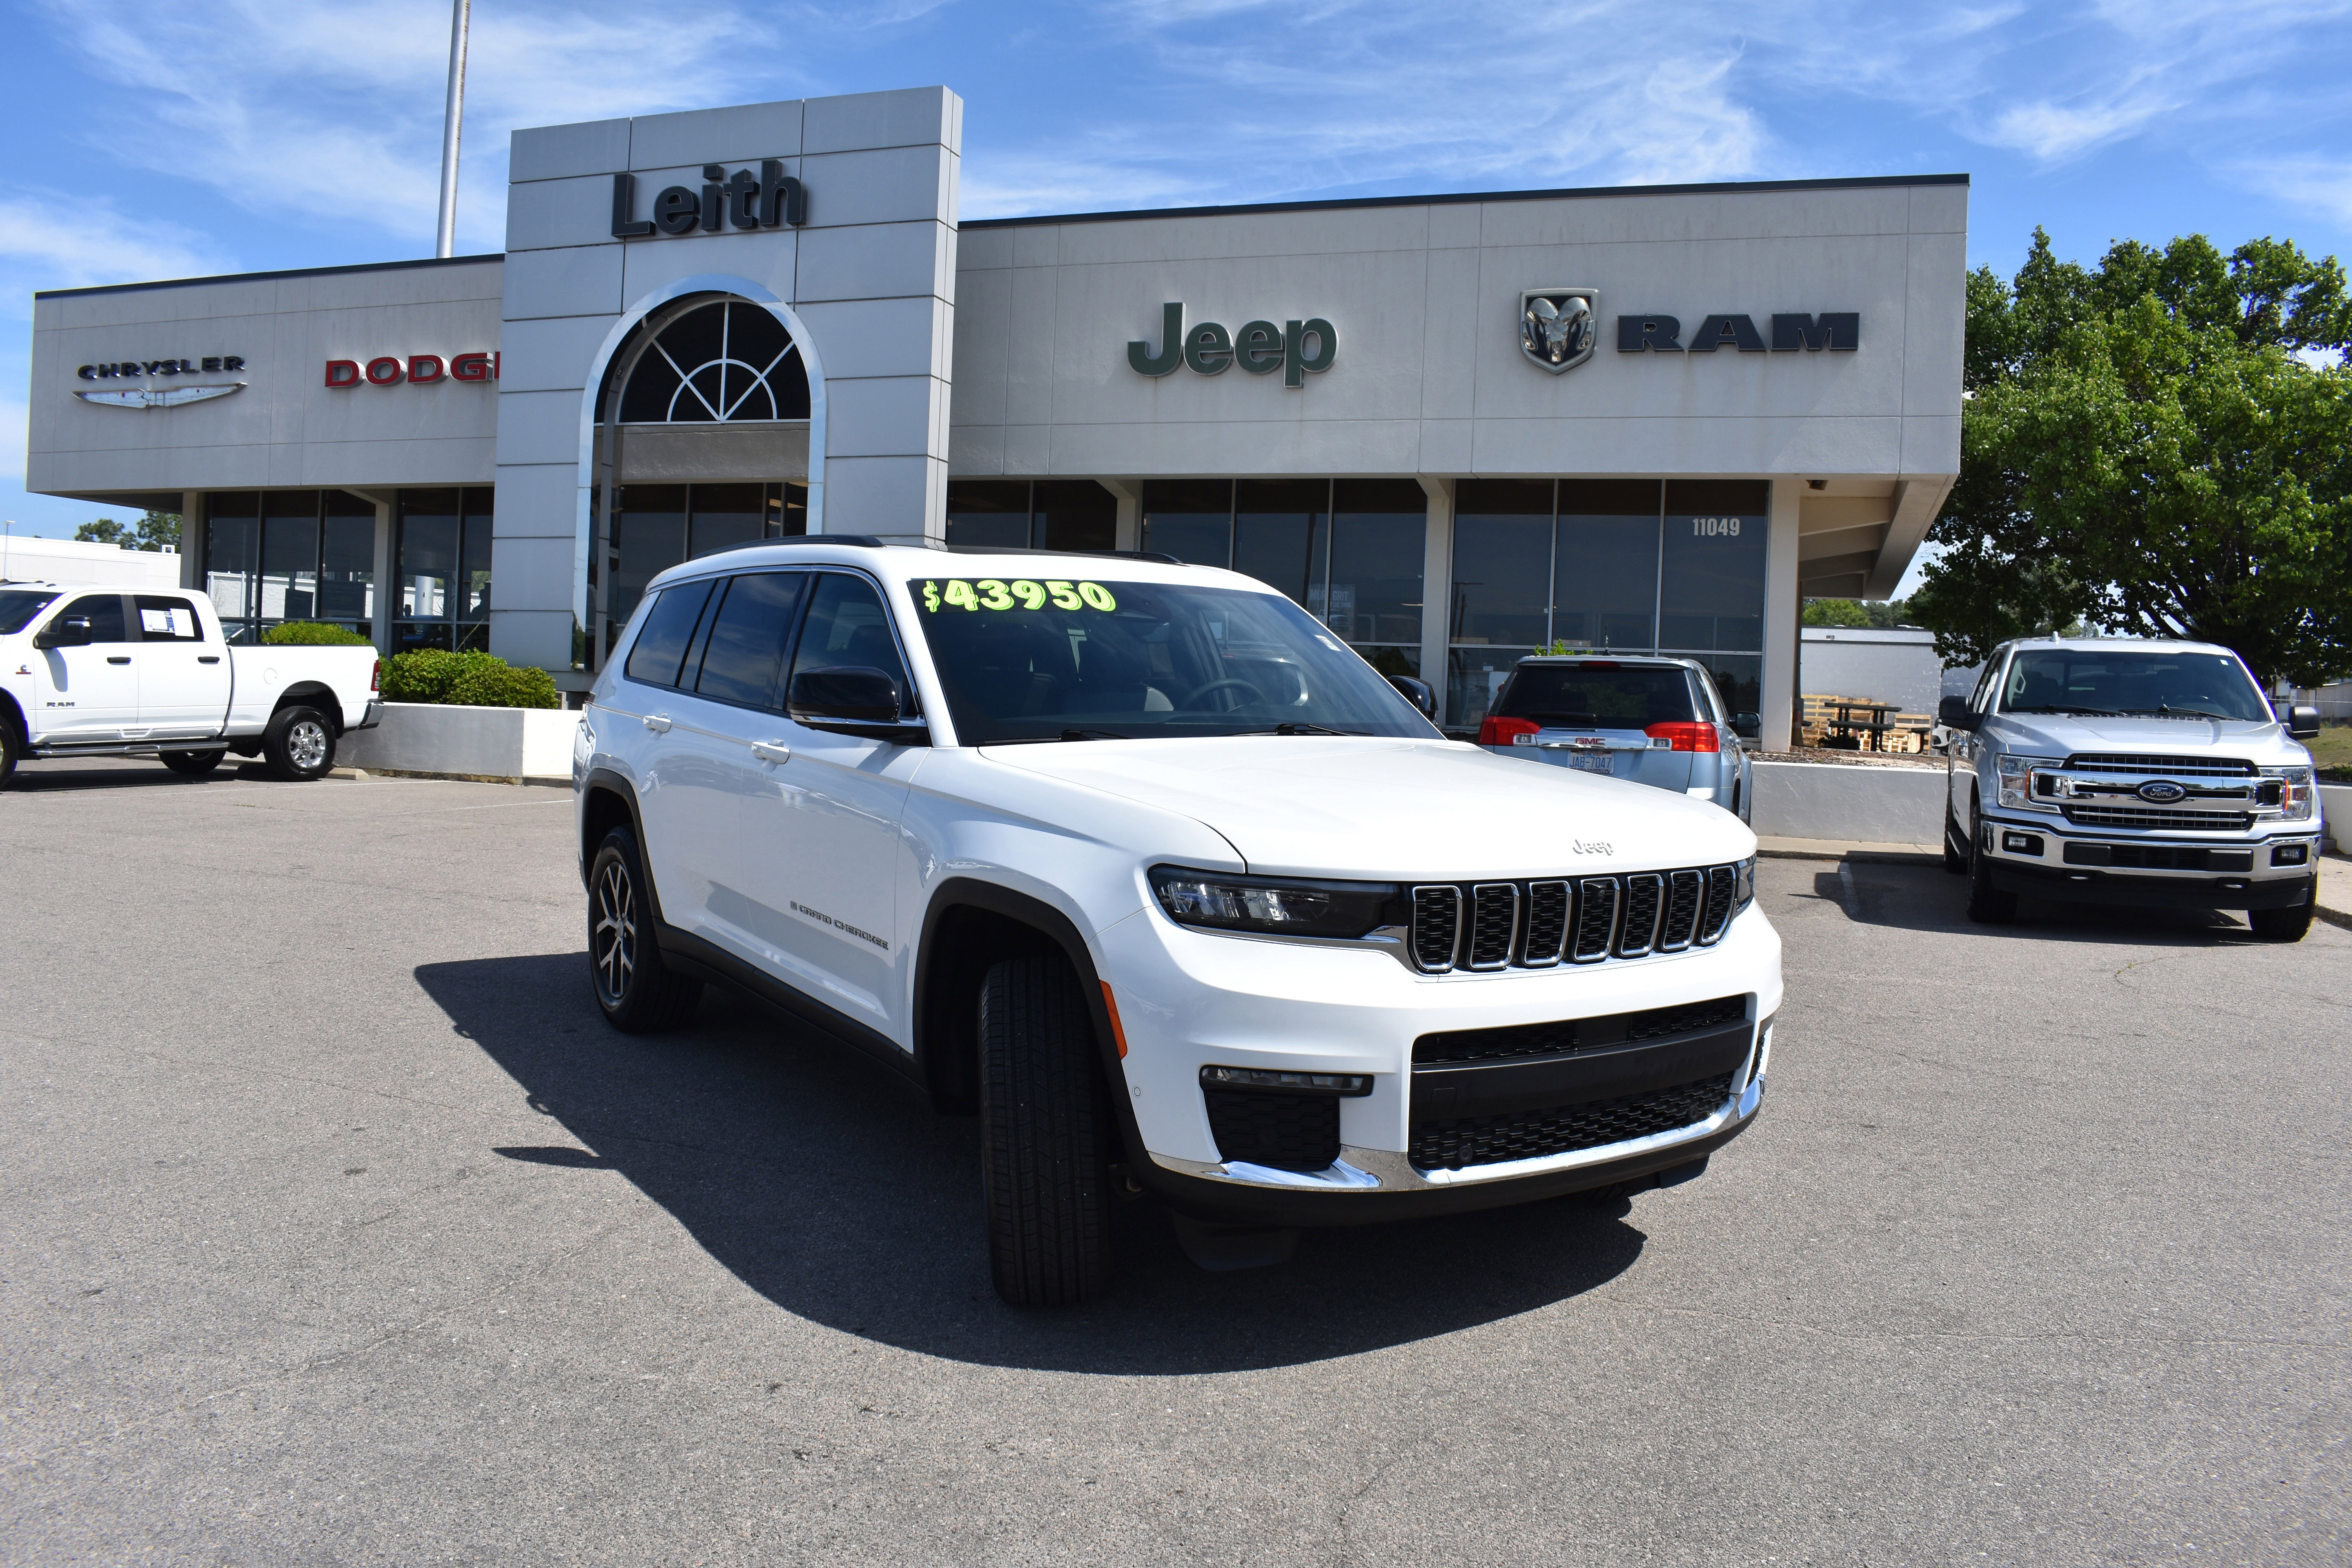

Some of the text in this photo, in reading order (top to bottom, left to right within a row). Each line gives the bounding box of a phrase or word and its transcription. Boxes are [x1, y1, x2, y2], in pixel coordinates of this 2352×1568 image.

[611, 159, 807, 238] Leith
[1127, 302, 1339, 388] Jeep
[1617, 312, 1860, 353] RAM
[78, 356, 245, 380] CHRYSLER
[325, 351, 501, 389] DODG
[1693, 518, 1740, 536] 11049
[923, 580, 1116, 612] $43950
[1332, 590, 1349, 601] GRIT
[1570, 756, 1612, 768] JAB-7047
[2149, 787, 2174, 797] Ford
[1572, 839, 1614, 856] Jeep
[799, 904, 889, 950] GRAND CHEROKEE
